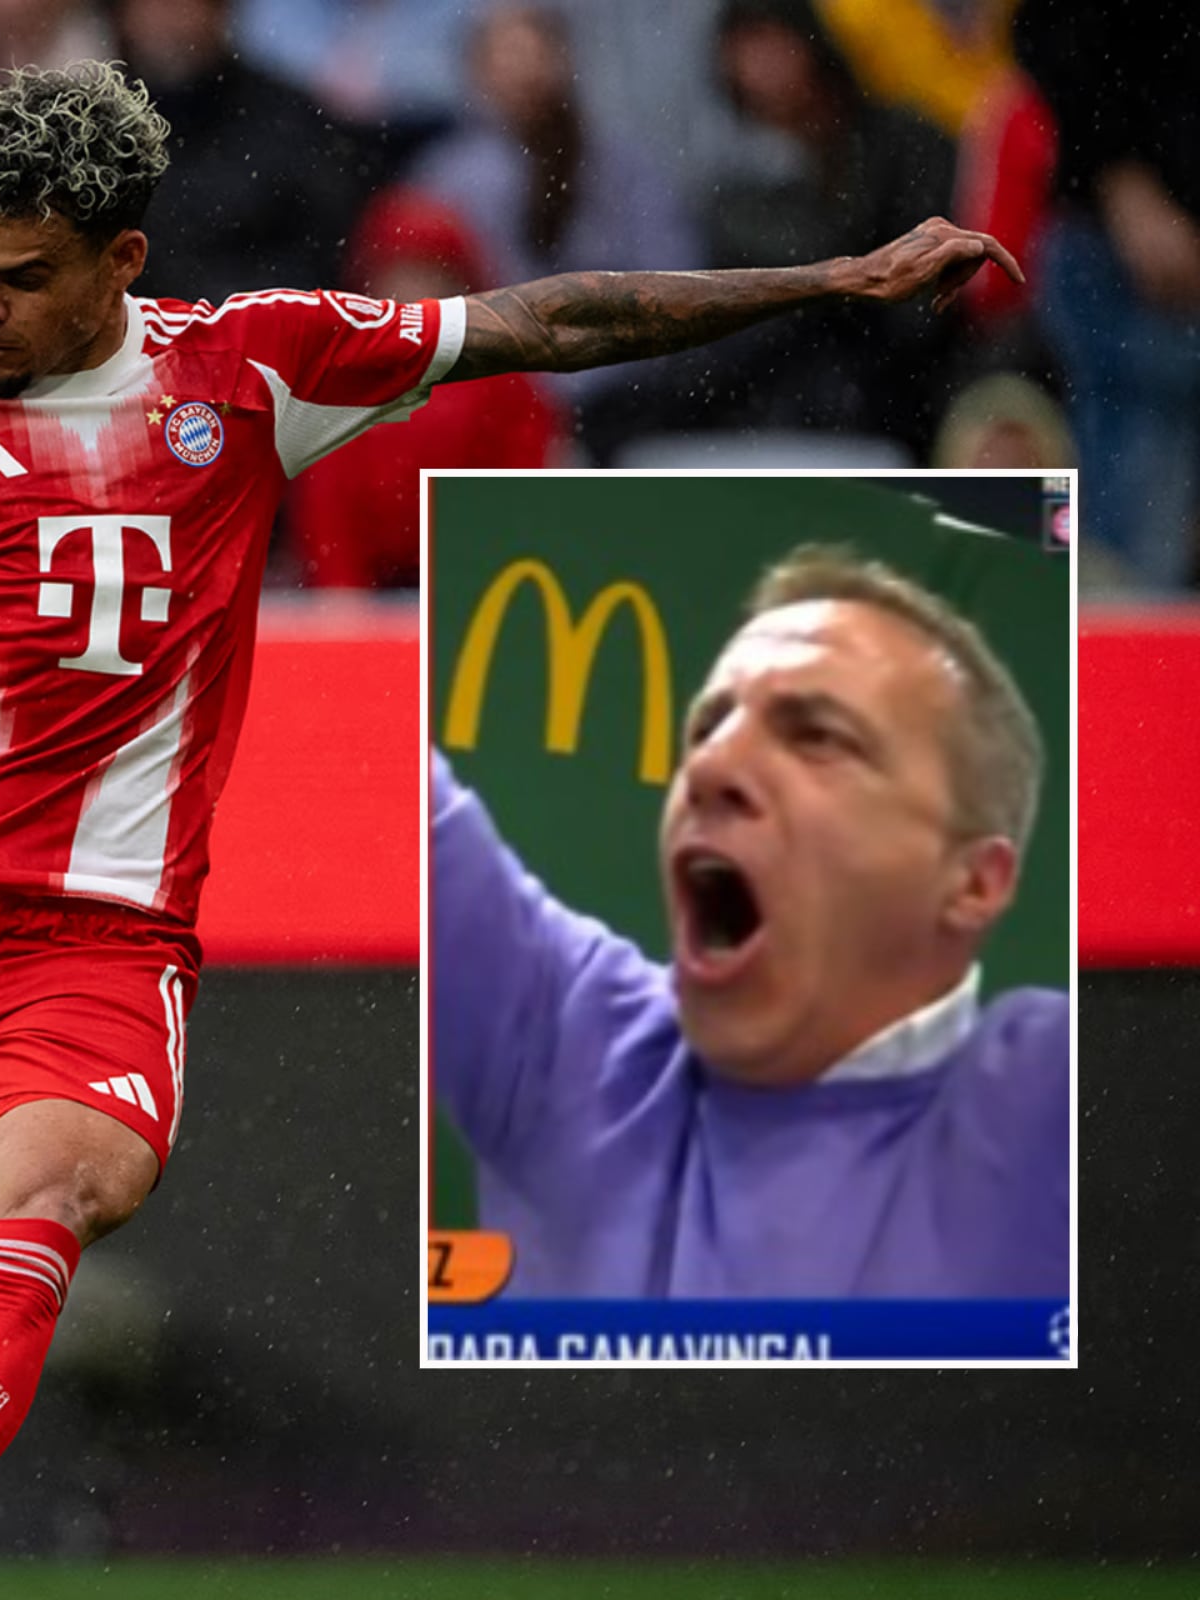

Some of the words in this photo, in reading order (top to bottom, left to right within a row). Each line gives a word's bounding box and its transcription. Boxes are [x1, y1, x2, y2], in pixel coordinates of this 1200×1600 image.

[169, 417, 181, 433] FC
[179, 405, 217, 428] BAYERN
[38, 514, 173, 676] T
